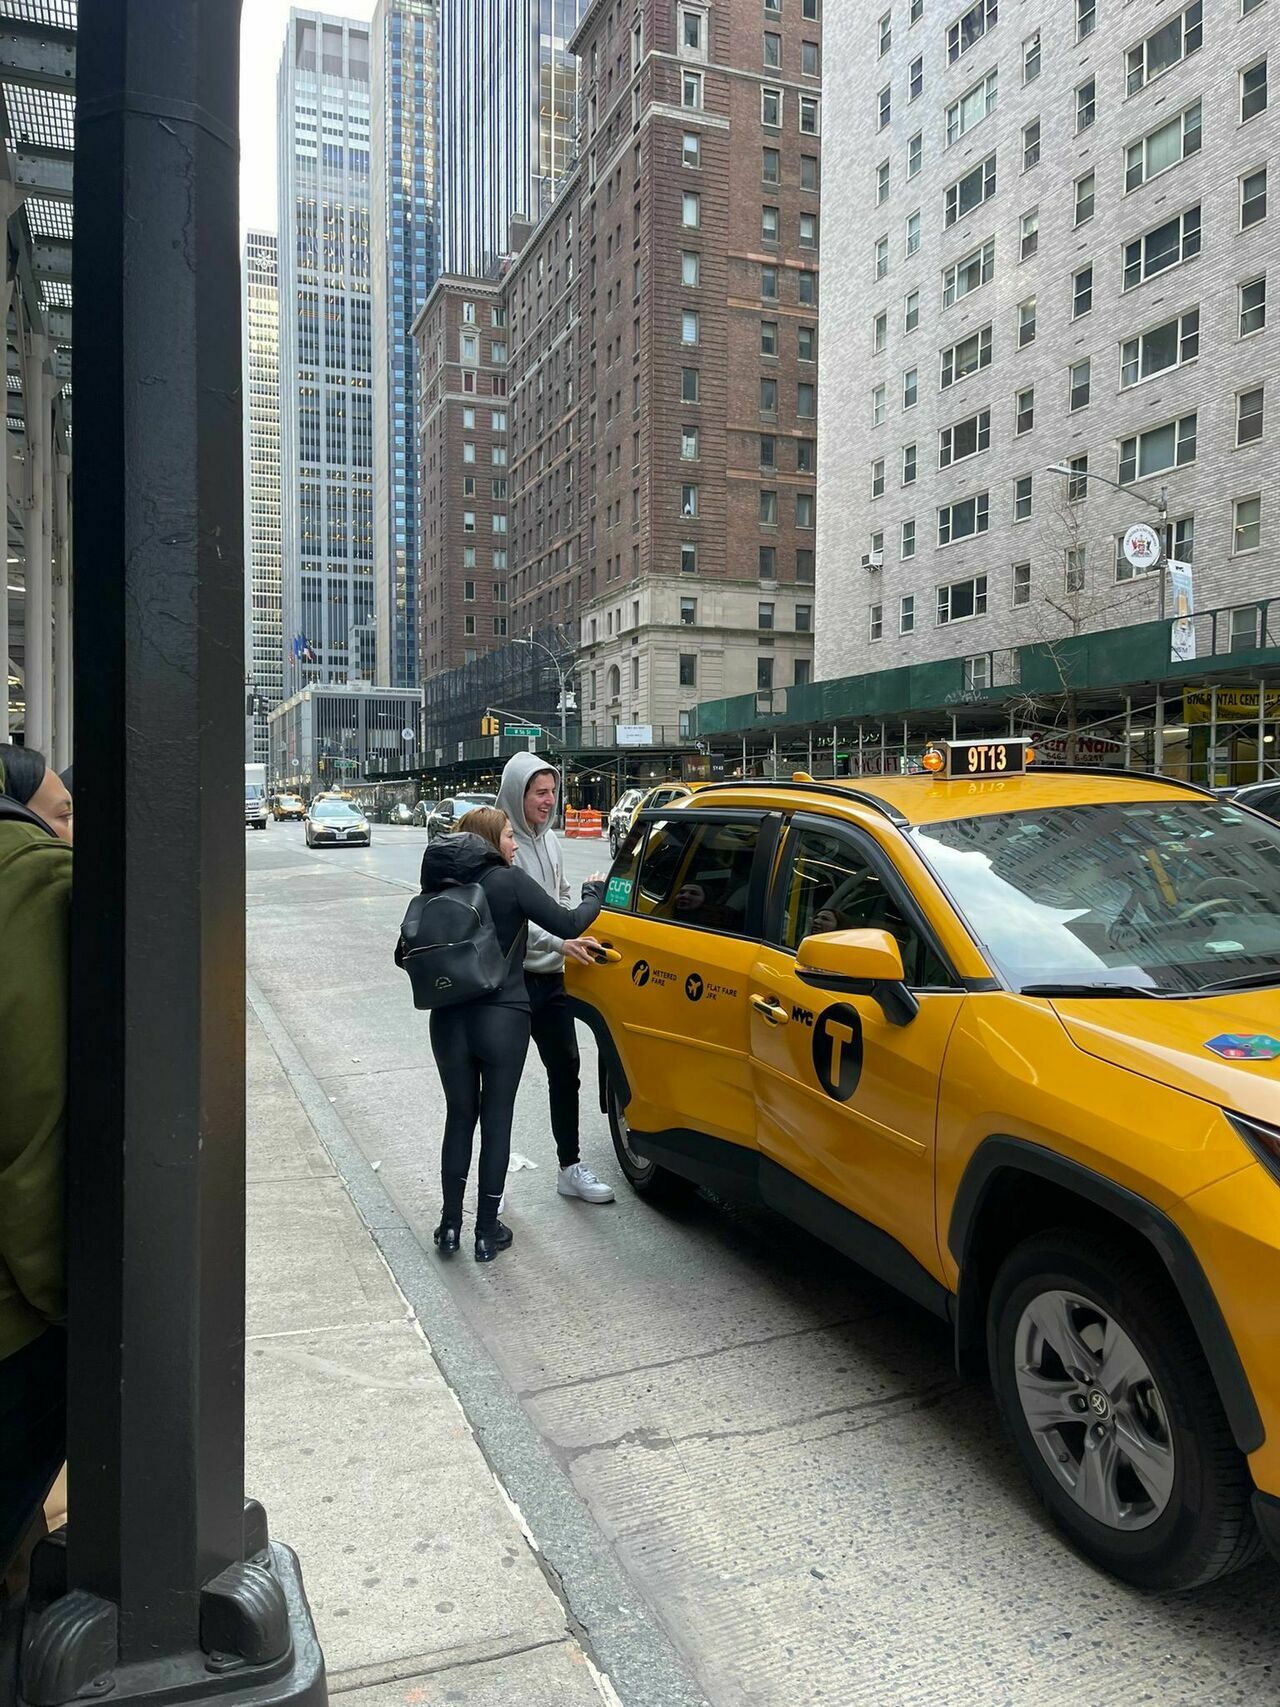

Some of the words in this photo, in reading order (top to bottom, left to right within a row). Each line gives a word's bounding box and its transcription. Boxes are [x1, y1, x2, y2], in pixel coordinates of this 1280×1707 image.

[1207, 693, 1237, 706] RNTAL
[1239, 693, 1274, 706] CENTAL
[967, 745, 1007, 772] 9T13
[608, 880, 632, 894] curb
[652, 969, 677, 981] METERED
[651, 977, 666, 987] FARE
[706, 983, 721, 993] FLAT
[721, 987, 737, 997] FARE
[706, 992, 717, 1000] JFK
[792, 1006, 814, 1027] NYC
[824, 1018, 854, 1088] T
